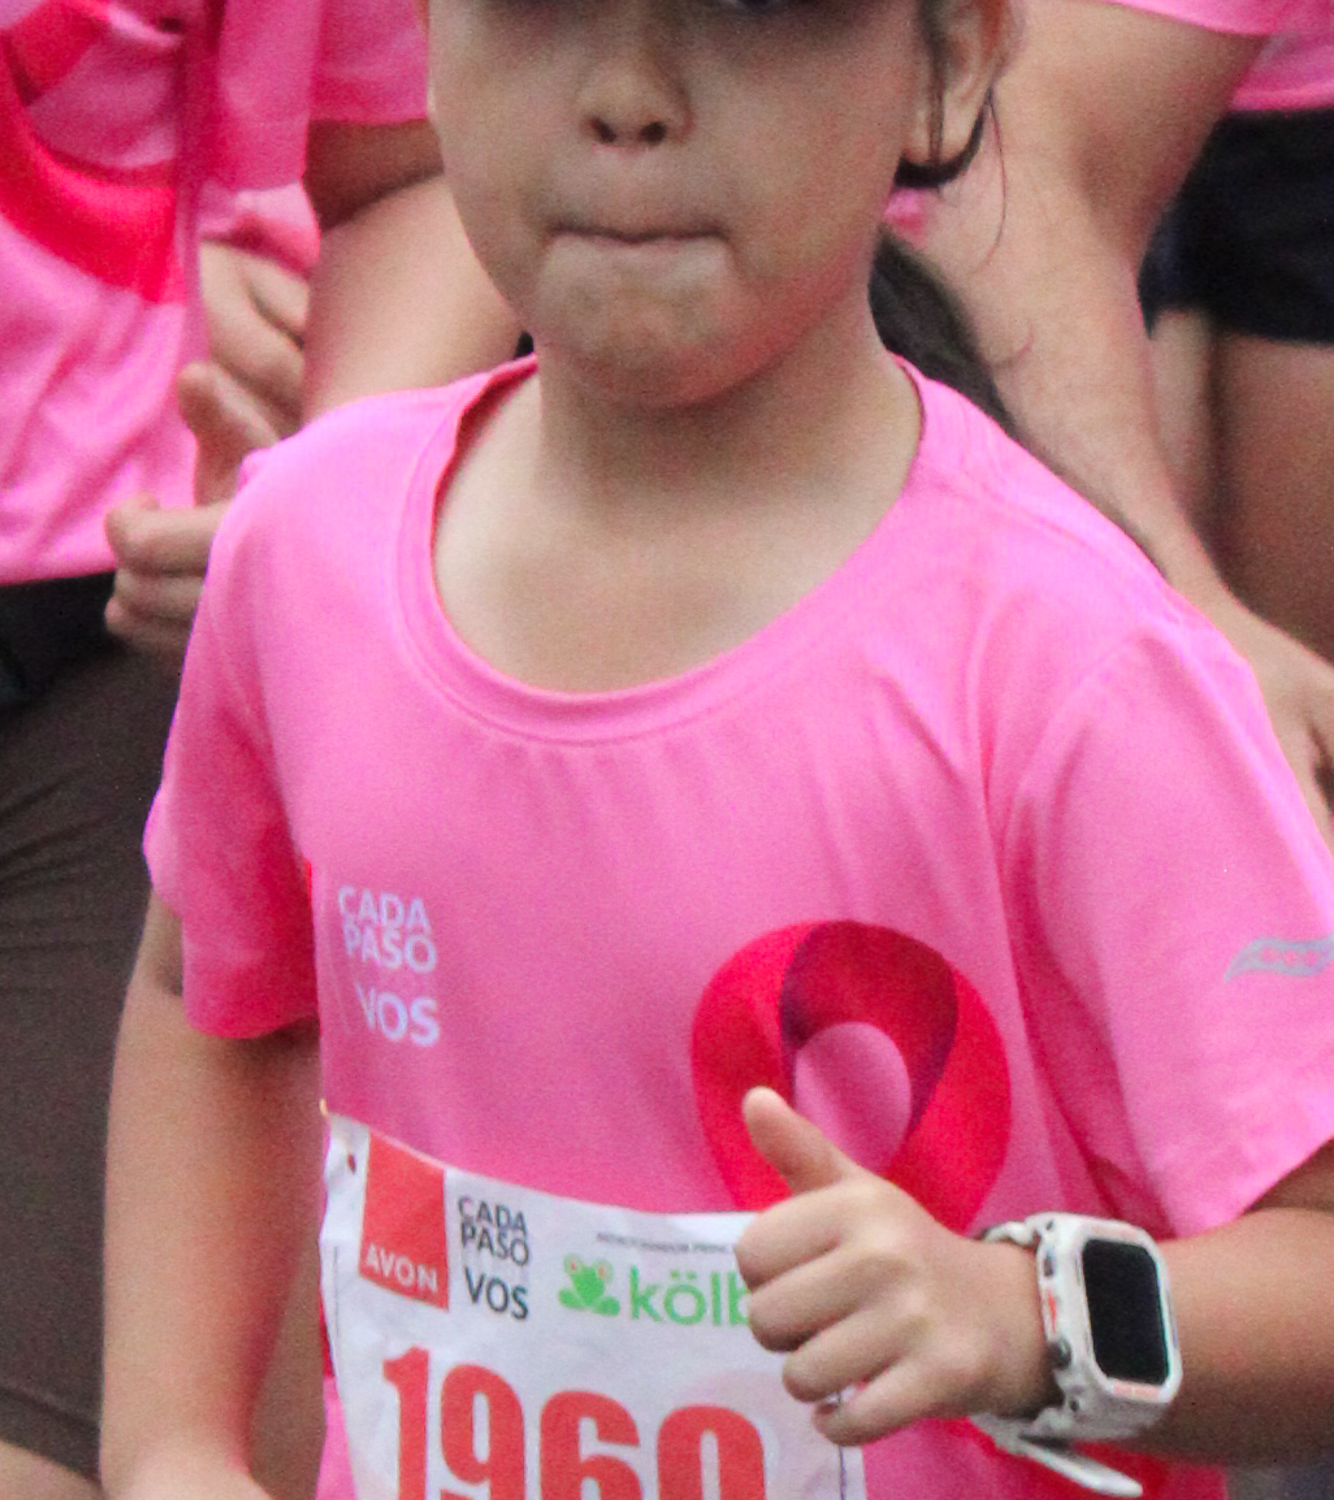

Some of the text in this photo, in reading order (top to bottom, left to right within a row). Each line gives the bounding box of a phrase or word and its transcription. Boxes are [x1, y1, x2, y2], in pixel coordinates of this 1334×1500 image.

[337, 884, 433, 937] CADA
[343, 914, 438, 974] PASO
[354, 980, 440, 1047] VOS
[458, 1196, 528, 1238] CADA
[365, 1243, 439, 1294] AVON
[460, 1218, 530, 1277] PASO
[464, 1265, 529, 1321] VOS
[629, 1264, 752, 1326] kölb
